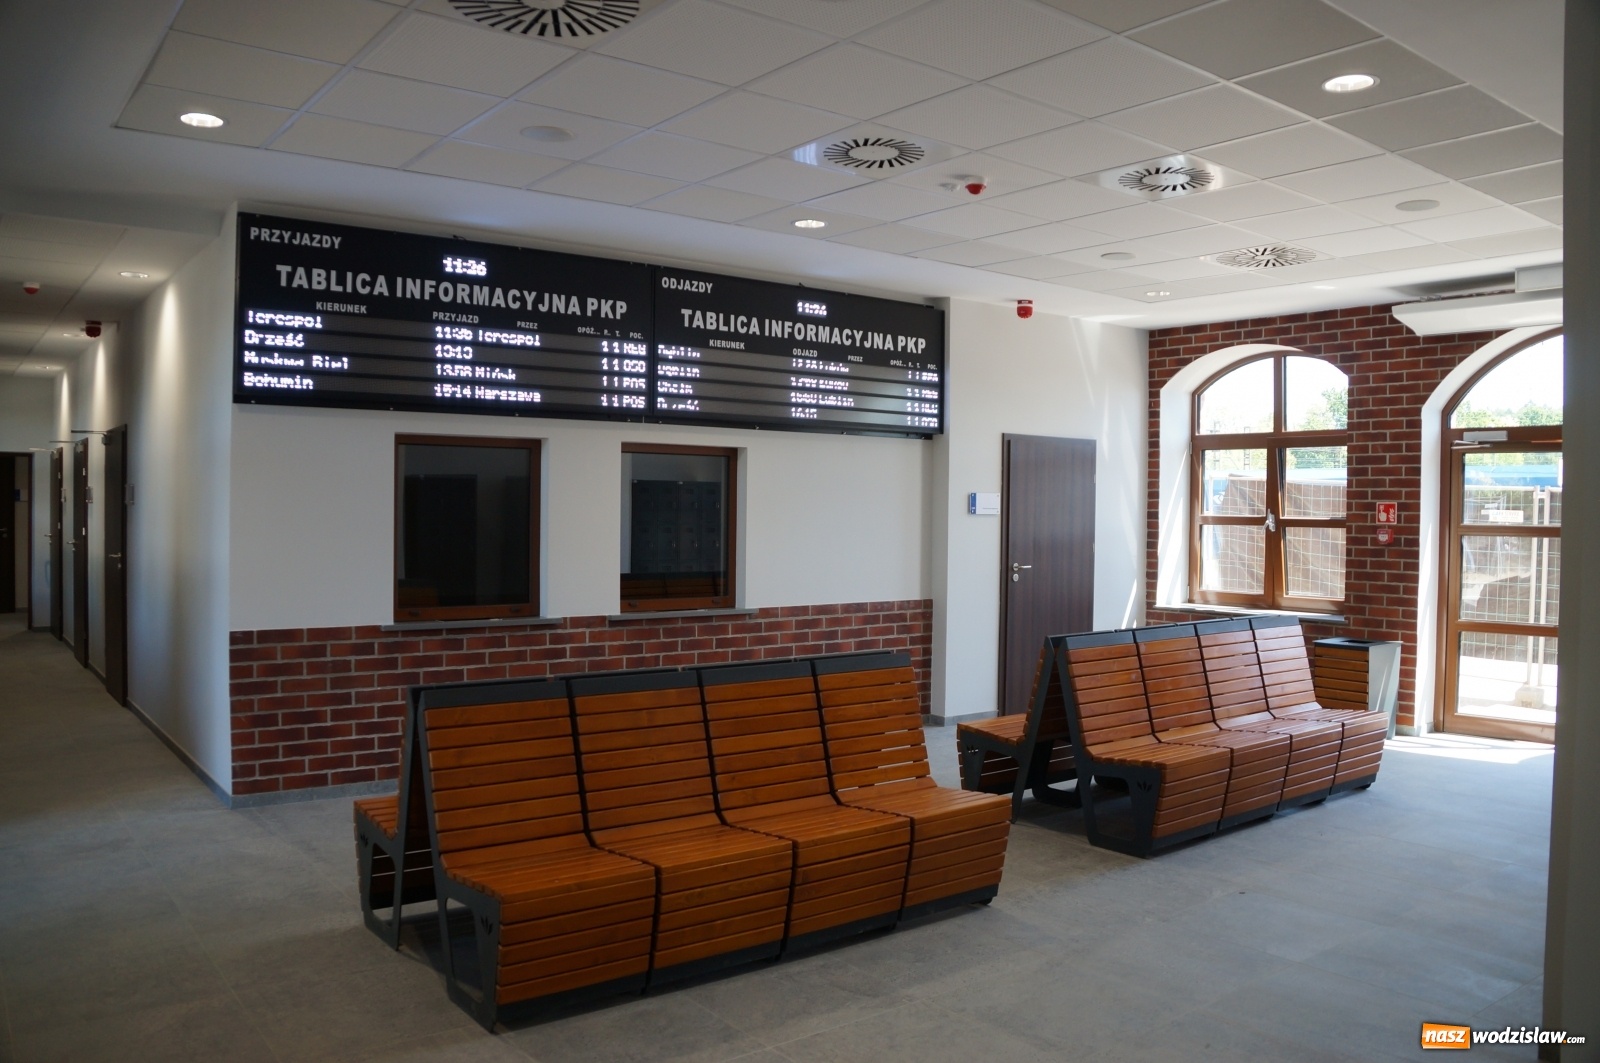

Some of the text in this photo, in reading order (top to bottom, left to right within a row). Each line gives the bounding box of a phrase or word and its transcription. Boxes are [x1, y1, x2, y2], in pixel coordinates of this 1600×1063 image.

[250, 226, 342, 249] PRZYJAZDY
[443, 256, 487, 276] 11:26
[276, 264, 627, 320] TABLICA INFORMACYJNA PKP
[661, 276, 713, 293] ODJAZDY
[315, 301, 367, 314] KIERUNEK
[432, 311, 479, 324] PRZYJAZD
[517, 320, 538, 330] PRZEZ
[681, 308, 926, 355] TABLICA INFORMACYJNA PKP
[709, 339, 745, 350] KIERUNEK
[792, 348, 818, 358] ODJAZD
